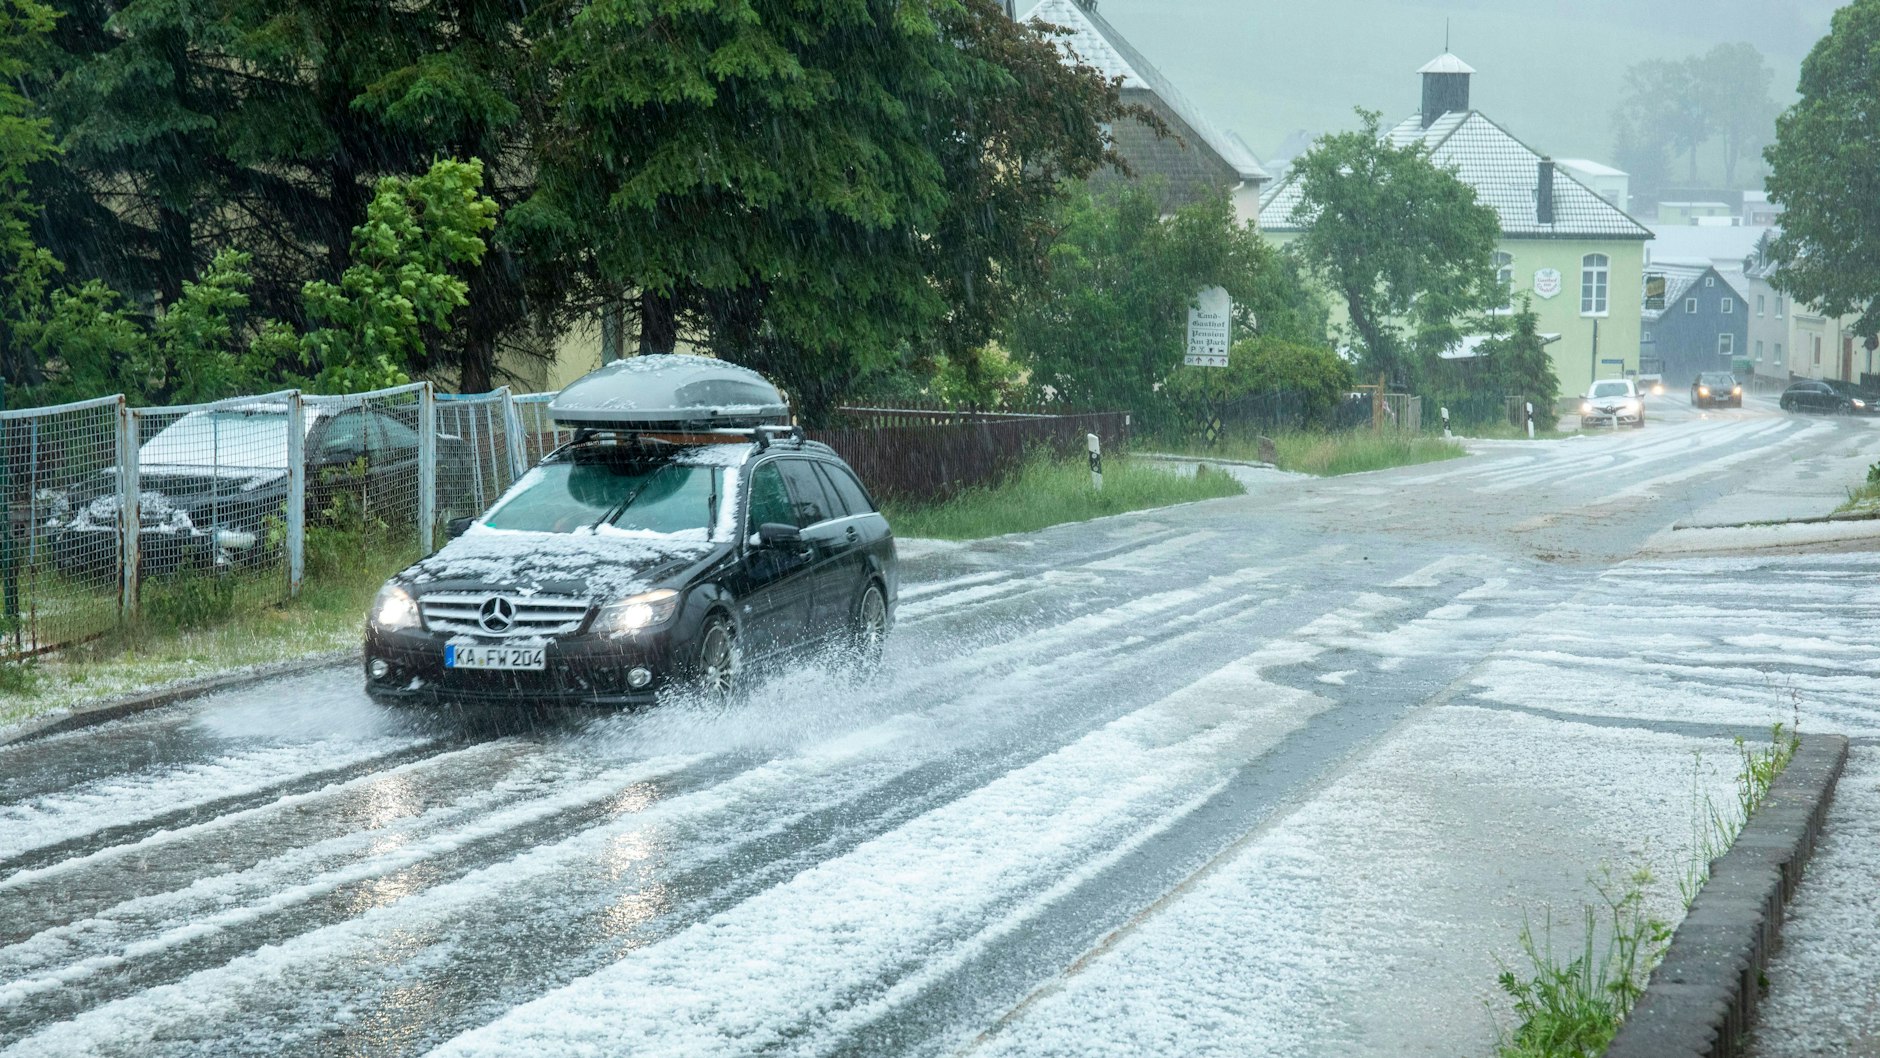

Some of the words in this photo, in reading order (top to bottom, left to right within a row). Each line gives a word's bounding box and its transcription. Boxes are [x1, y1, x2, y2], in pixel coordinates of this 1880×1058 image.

[1192, 320, 1225, 328] Gasthof
[1192, 330, 1225, 338] Pension
[1206, 338, 1226, 346] Park
[456, 648, 475, 665] KA
[487, 649, 508, 666] FW
[511, 649, 543, 666] 204
